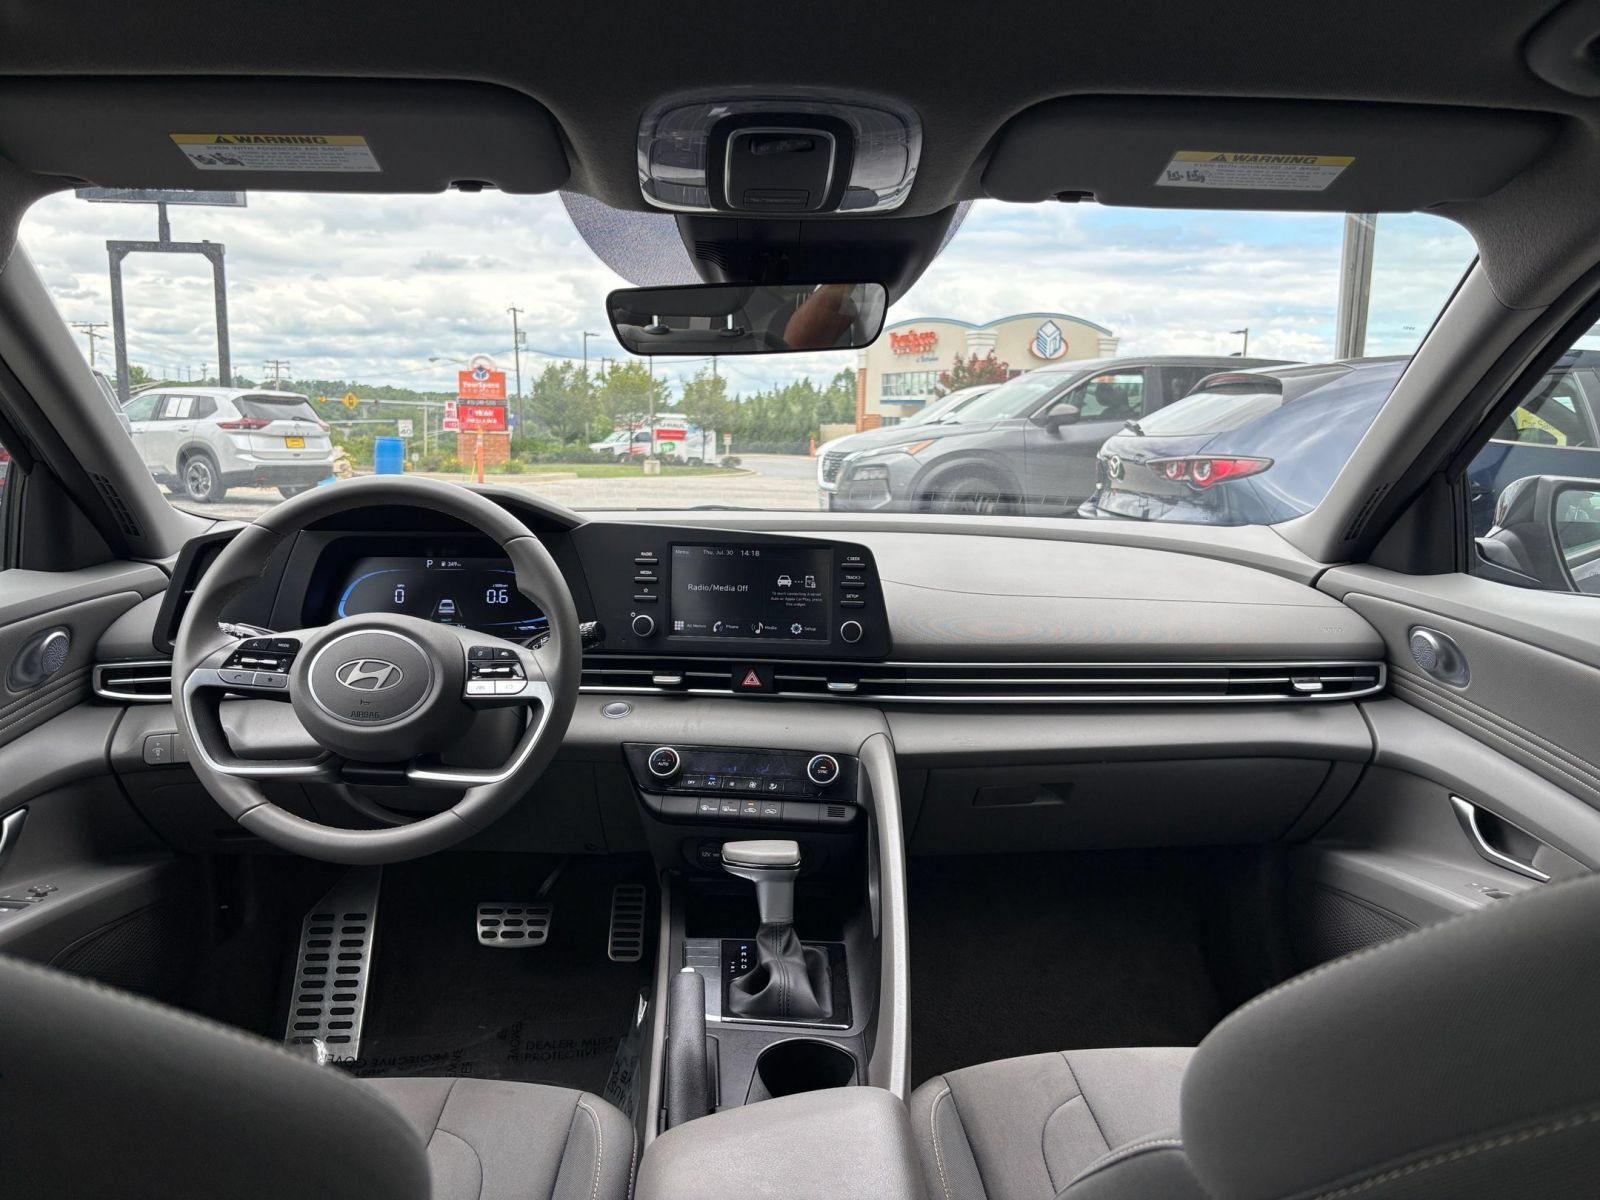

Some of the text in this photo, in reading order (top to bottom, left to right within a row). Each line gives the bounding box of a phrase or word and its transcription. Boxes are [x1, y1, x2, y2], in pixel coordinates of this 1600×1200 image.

[234, 135, 328, 145] WARNING
[1231, 154, 1318, 165] WARNING
[426, 559, 434, 568] P
[687, 583, 749, 592] Radio/Media Off
[394, 589, 404, 604] 0
[486, 589, 508, 604] 0.6
[526, 1039, 576, 1051] DEALER
